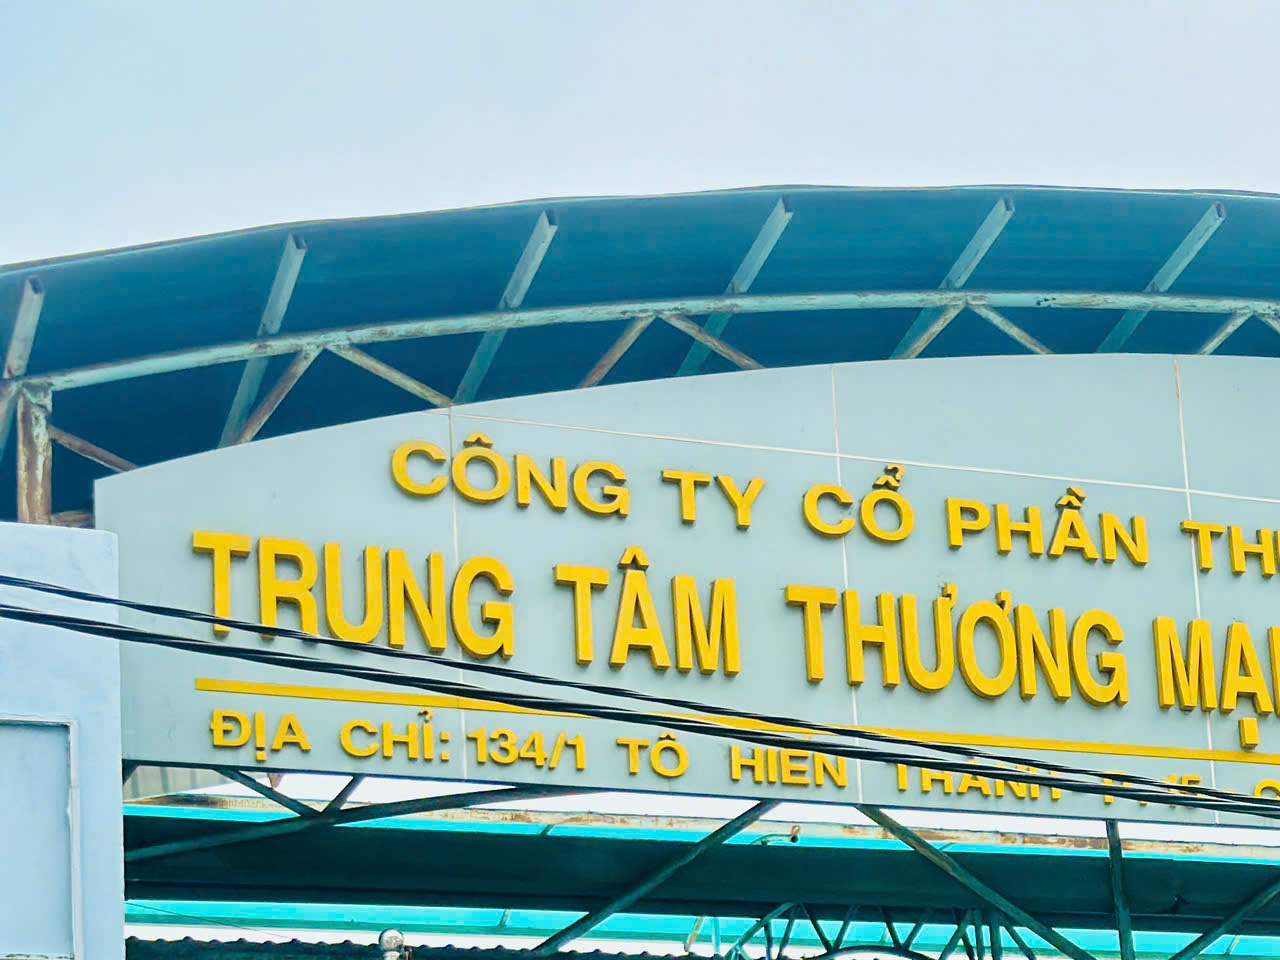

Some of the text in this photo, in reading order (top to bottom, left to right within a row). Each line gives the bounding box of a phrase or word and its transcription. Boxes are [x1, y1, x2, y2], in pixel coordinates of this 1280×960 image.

[391, 432, 630, 517] CÔNG
[662, 470, 765, 529] TY
[802, 463, 915, 543] CỔ
[946, 487, 1148, 566] PHẦN
[192, 530, 515, 661] TRUNG
[554, 545, 742, 677] TÂM
[785, 583, 1129, 707] THƯƠNG
[210, 708, 312, 762] ĐỊA
[339, 709, 451, 762] CHỈ:
[467, 727, 587, 771] 134/1
[616, 735, 690, 778] TÔ
